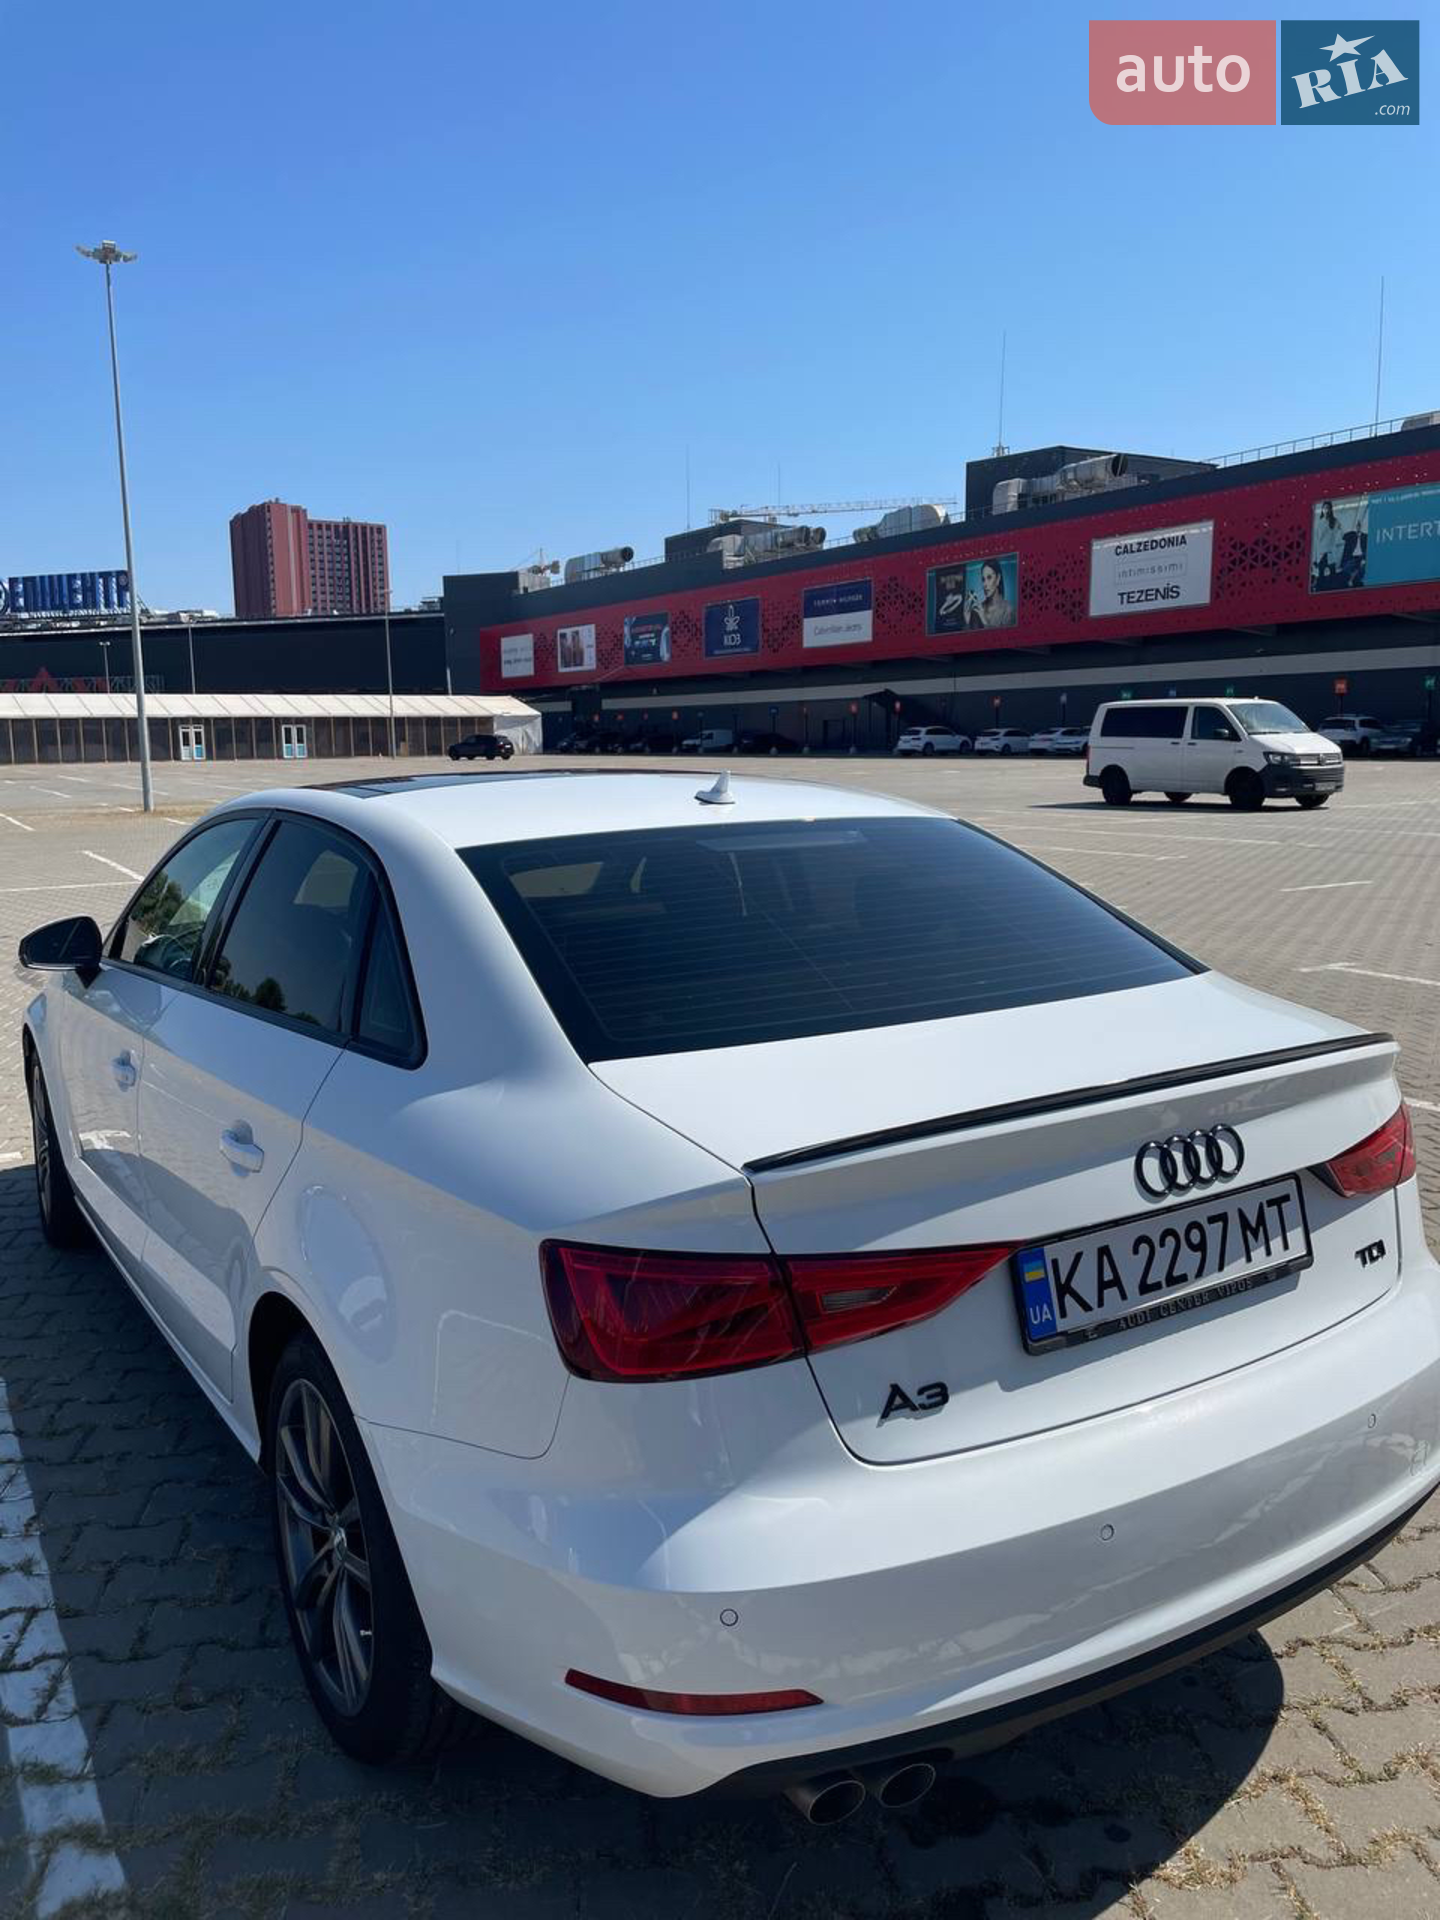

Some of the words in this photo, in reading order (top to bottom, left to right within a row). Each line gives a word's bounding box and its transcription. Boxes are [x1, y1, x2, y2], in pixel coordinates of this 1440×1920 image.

[1115, 534, 1188, 556] CALZEDONIA
[1030, 1303, 1053, 1326] UA
[1118, 1310, 1153, 1331] AUDI
[1159, 1290, 1210, 1318] CENTER
[880, 1381, 950, 1419] A3
